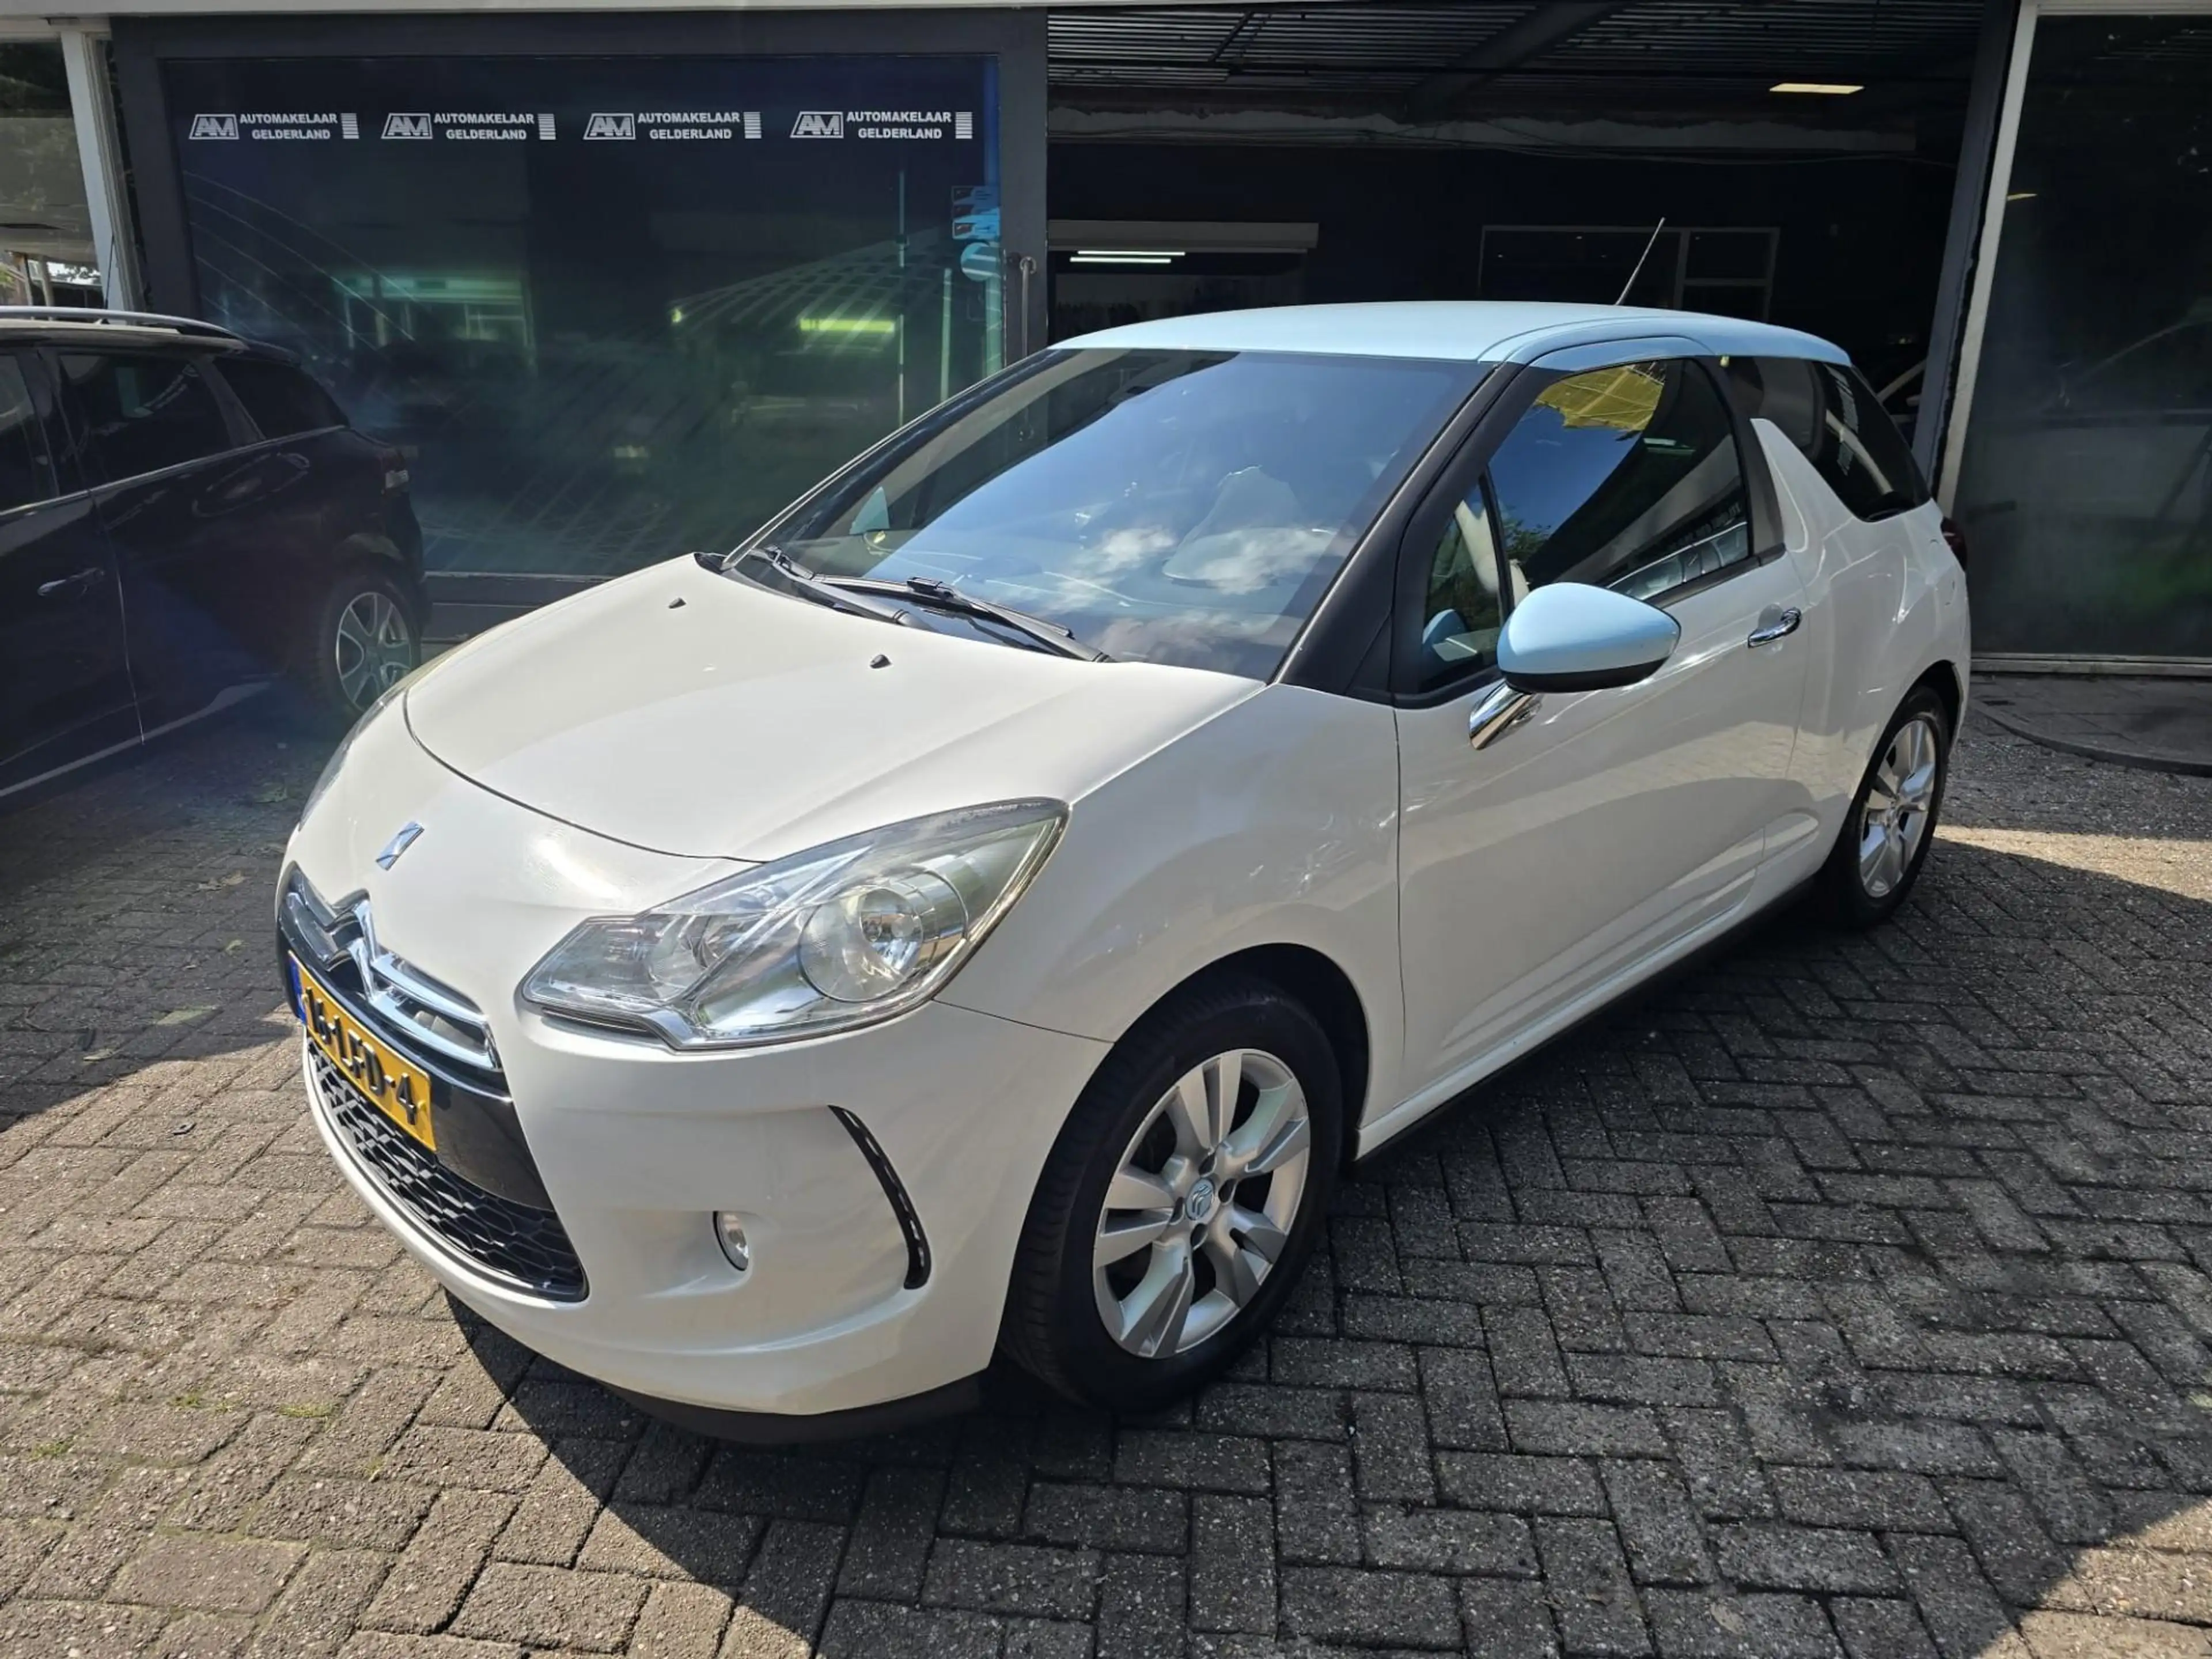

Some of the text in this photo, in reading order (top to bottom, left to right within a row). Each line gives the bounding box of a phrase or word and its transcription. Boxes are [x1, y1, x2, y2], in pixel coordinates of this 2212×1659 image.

[240, 113, 338, 124] AUTOMAKELAAR
[434, 113, 535, 124] AUTOMAKELAAR
[637, 112, 740, 124] AUTOMAKELAAR
[846, 111, 952, 123] AUTOMAKELAAR
[195, 118, 235, 136] AM
[387, 116, 427, 136] AM
[589, 117, 632, 137] AM
[796, 115, 840, 135] AM
[252, 129, 331, 139] GELDERLAND
[446, 129, 527, 139] GELDERLAND
[649, 128, 732, 139] GELDERLAND
[858, 128, 942, 139] GELDERLAND
